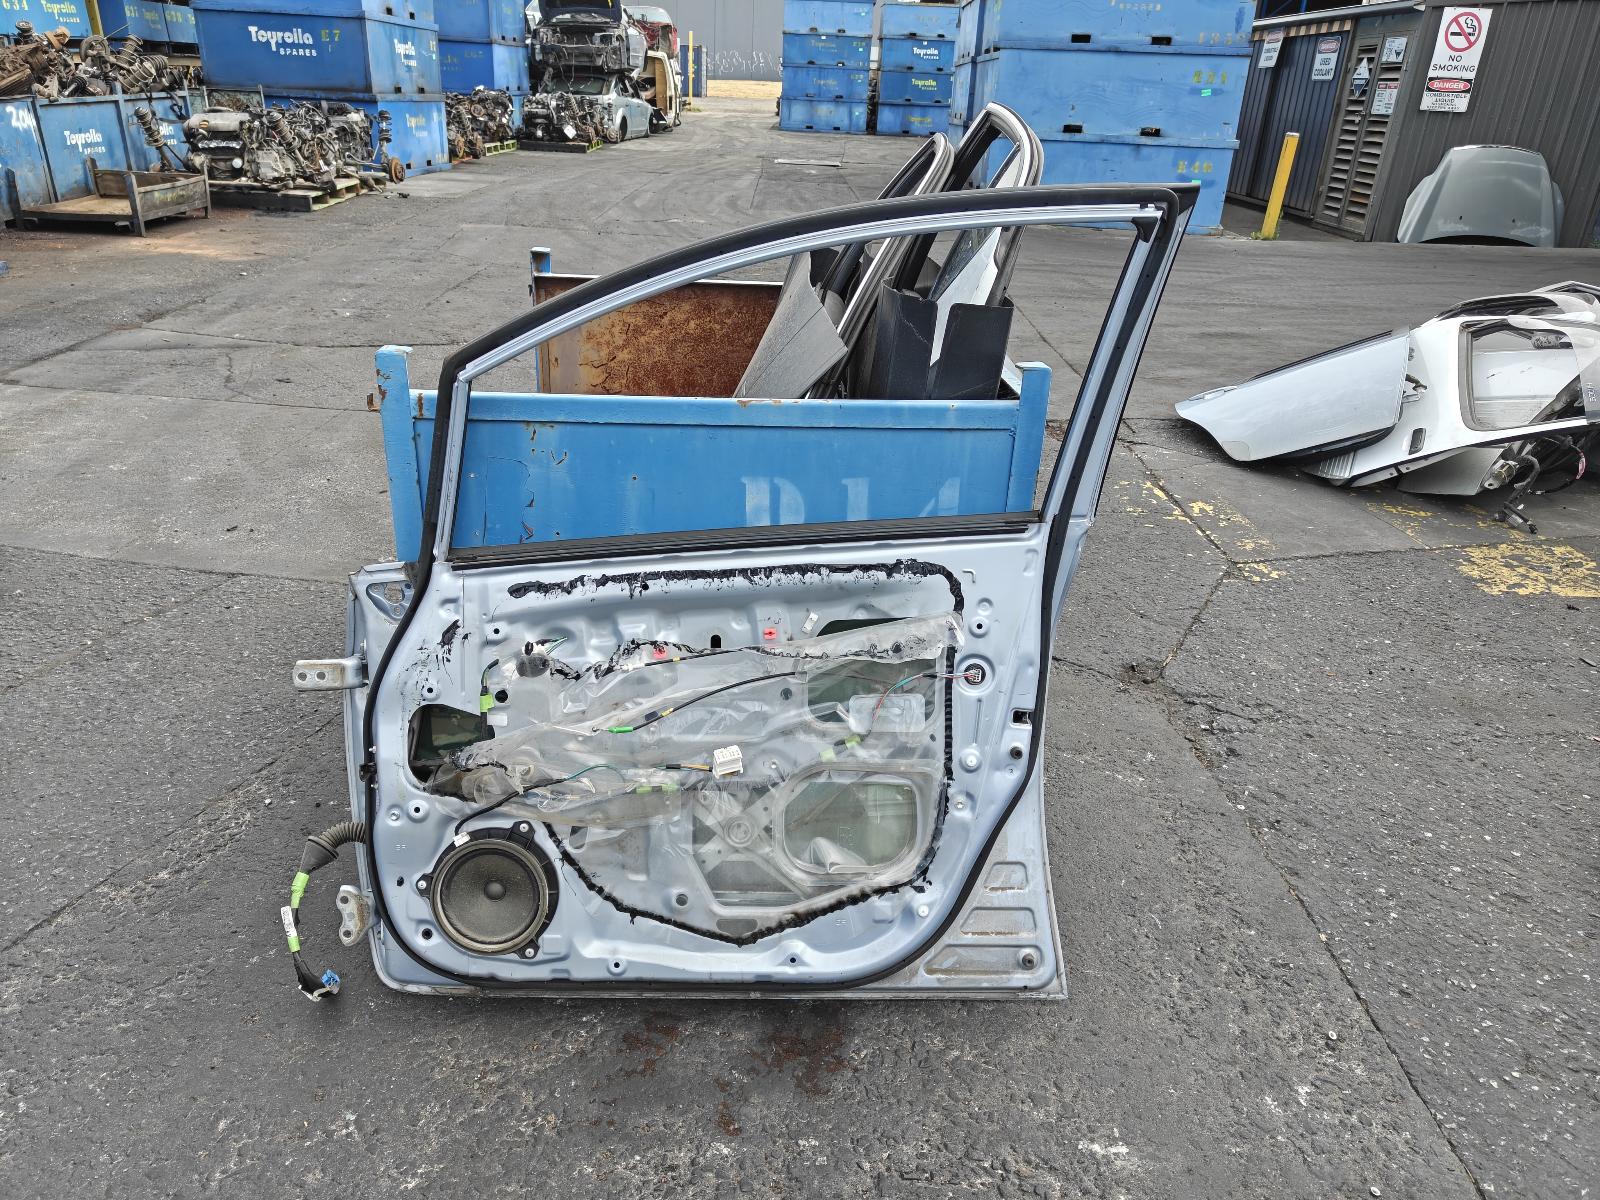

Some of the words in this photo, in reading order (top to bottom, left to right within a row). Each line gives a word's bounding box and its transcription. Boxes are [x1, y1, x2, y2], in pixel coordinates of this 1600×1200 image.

[247, 25, 313, 51] Toyrolla
[279, 47, 317, 57] SPARES
[912, 47, 938, 58] Toyrolla
[1448, 54, 1463, 62] NO
[1313, 68, 1333, 76] COOLANT
[1431, 63, 1476, 72] SMOKING
[1433, 81, 1466, 89] DANGER
[64, 129, 102, 153] Toyrolla
